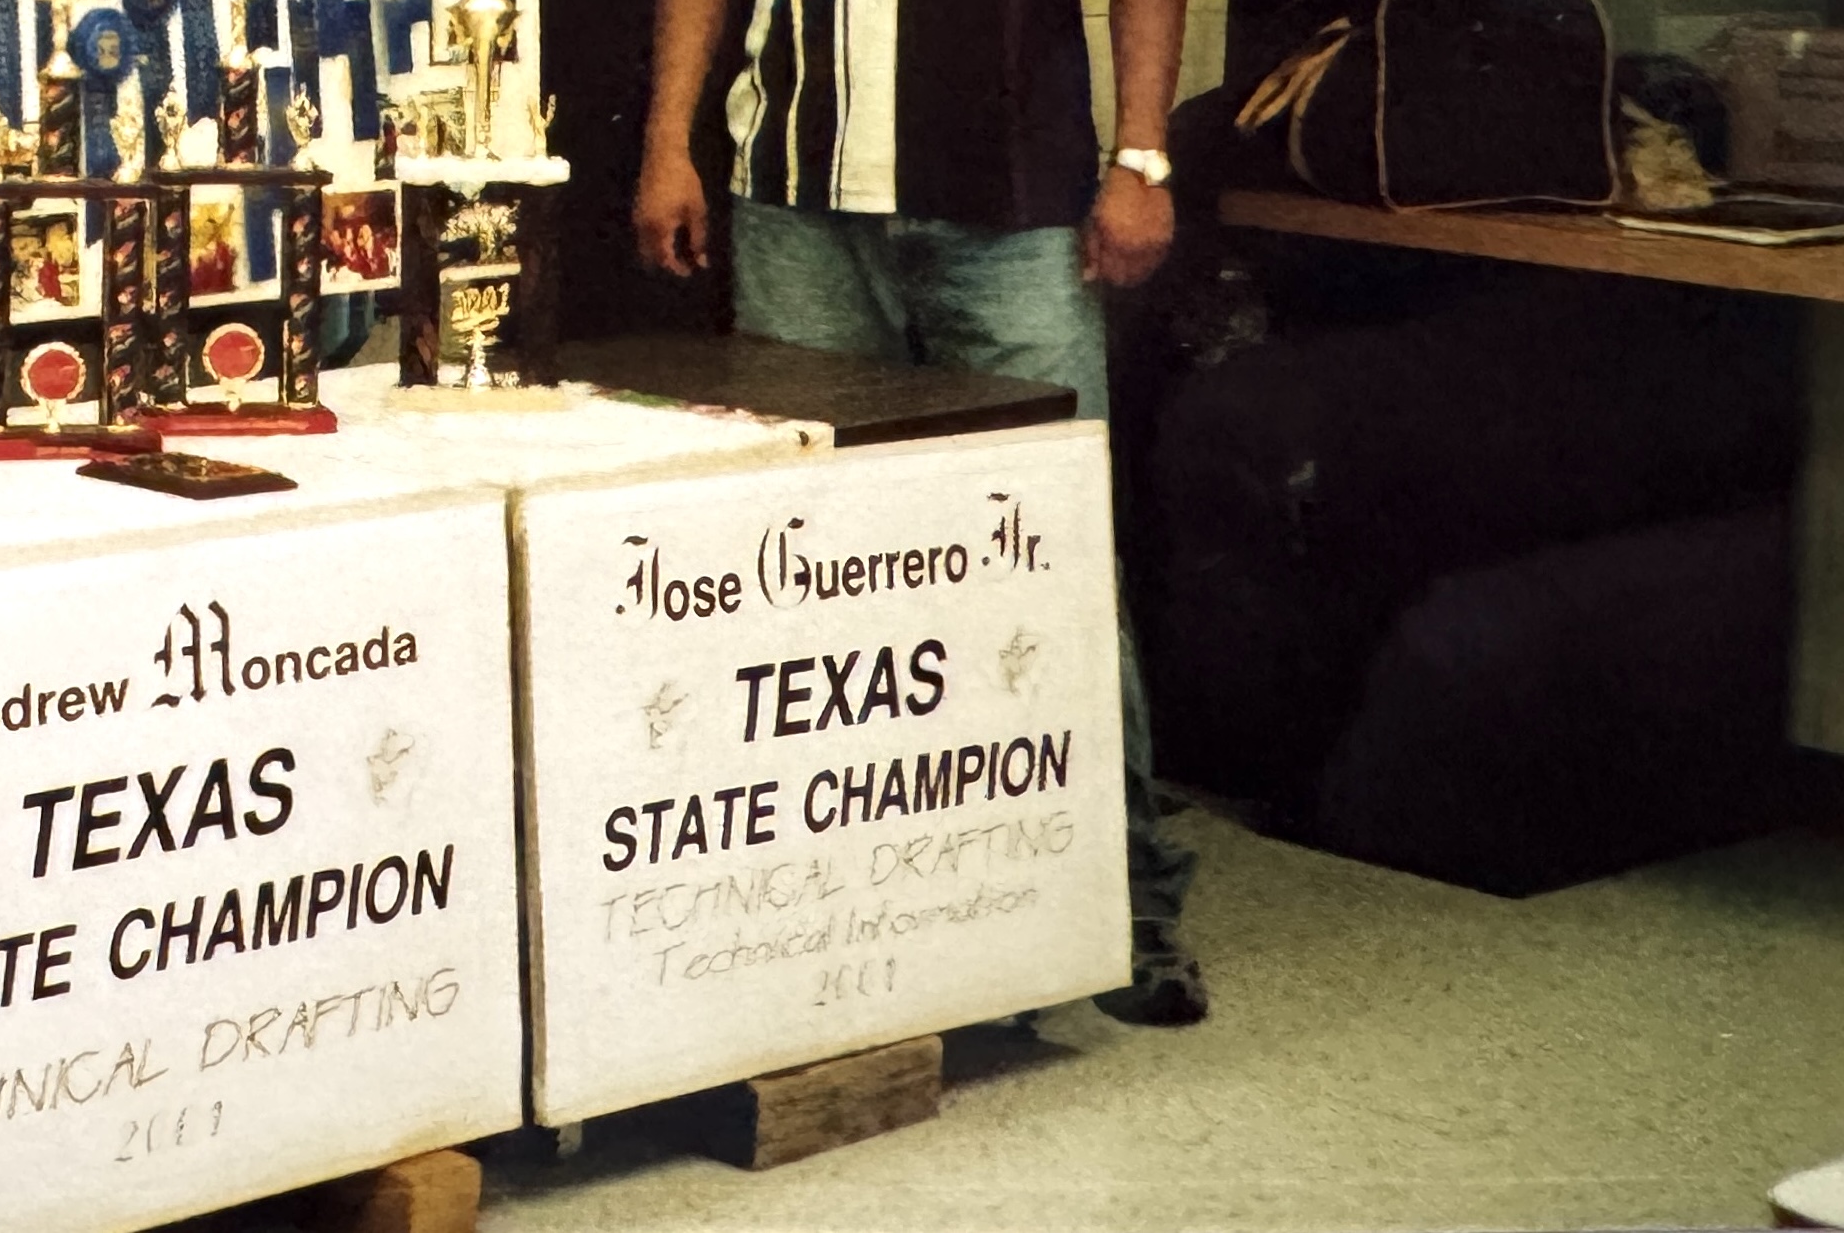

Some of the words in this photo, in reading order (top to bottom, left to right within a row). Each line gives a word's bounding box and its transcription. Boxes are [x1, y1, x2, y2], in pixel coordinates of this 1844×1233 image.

[614, 535, 743, 622] Jose
[757, 517, 967, 611] Guerrero
[979, 492, 1052, 574] Jr.
[150, 600, 419, 708] Moncada
[735, 639, 948, 743] TEXAS
[22, 747, 297, 879] TEXAS
[601, 780, 780, 874] STATE
[803, 729, 1072, 834] CHAMPION
[108, 843, 456, 981] CHAMPION
[599, 858, 847, 944] TECHNICAL
[870, 809, 1074, 886] DRAFTING
[200, 967, 461, 1072] DRAFTING
